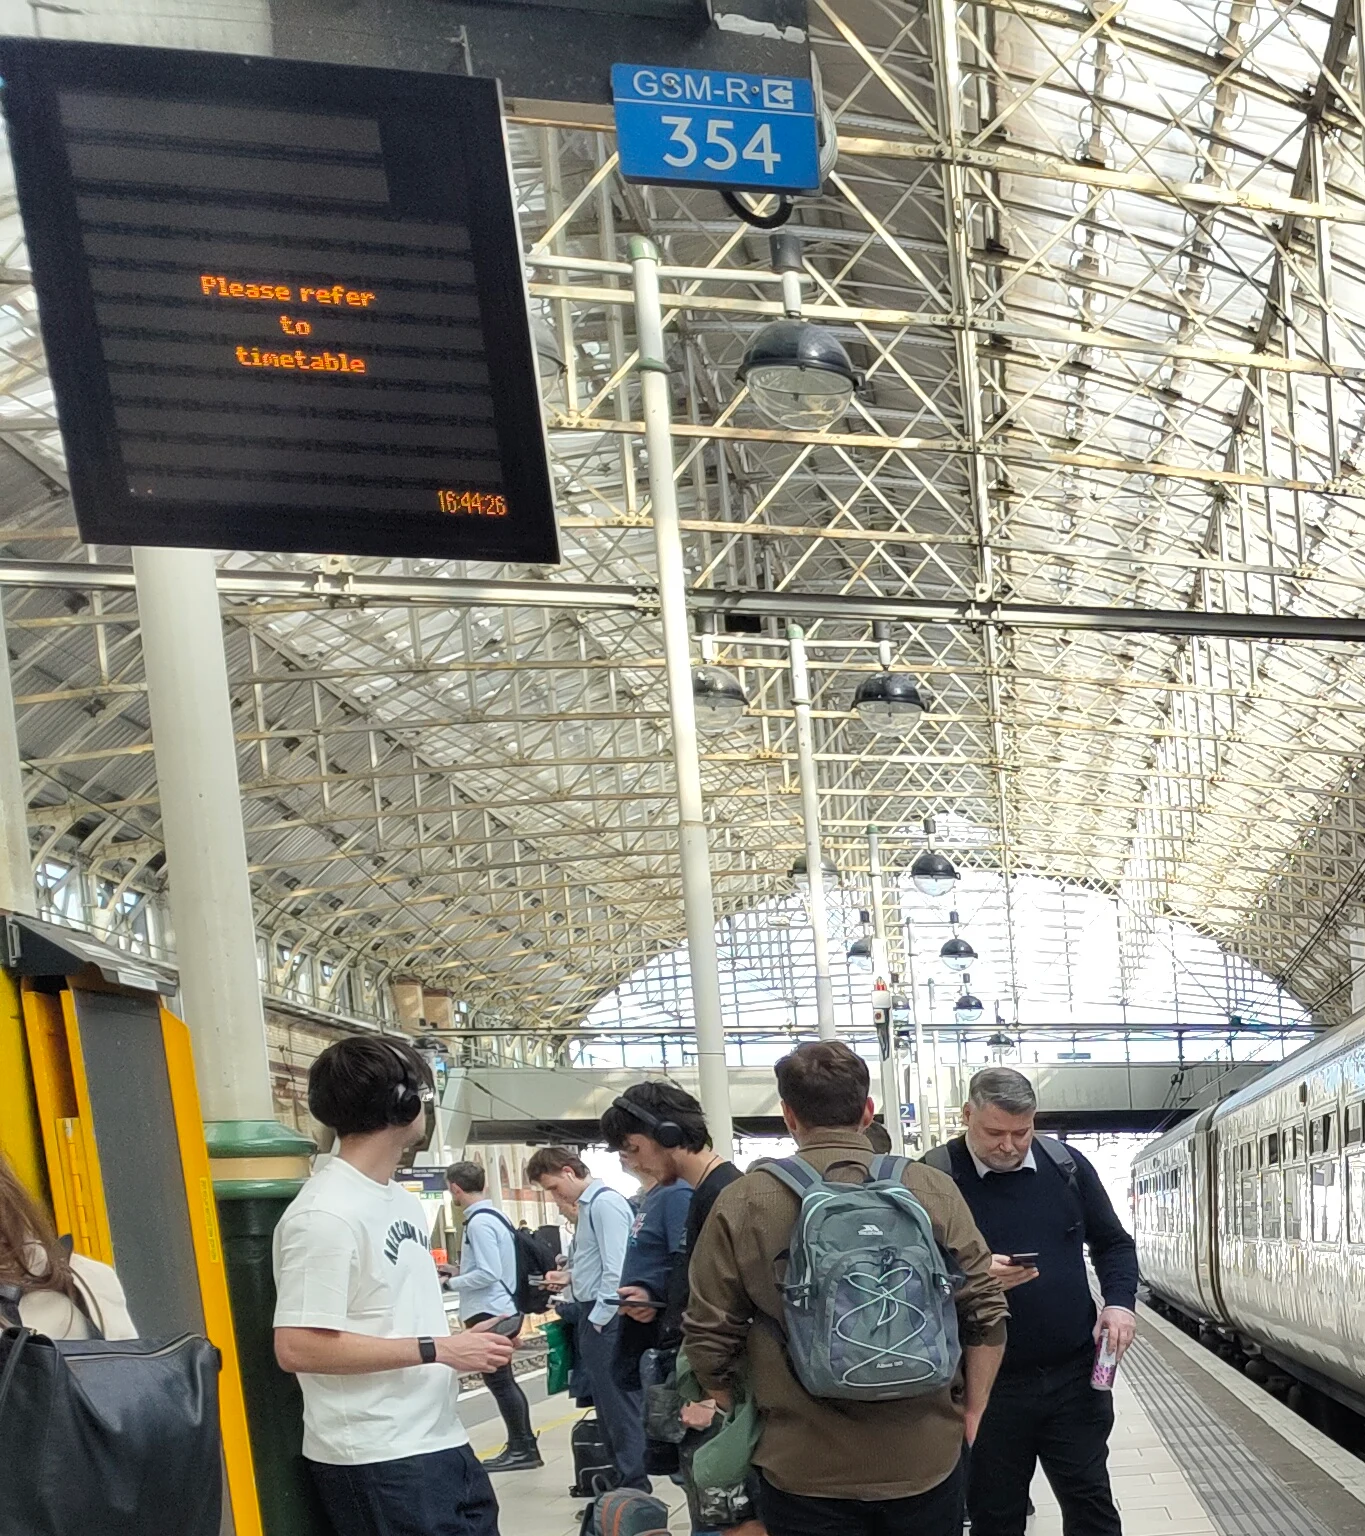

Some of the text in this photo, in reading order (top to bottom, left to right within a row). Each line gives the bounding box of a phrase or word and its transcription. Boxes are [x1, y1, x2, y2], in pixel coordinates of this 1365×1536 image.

[633, 70, 751, 104] GSM-R
[661, 115, 781, 175] 354
[201, 275, 375, 307] Please refer
[279, 315, 311, 336] to
[235, 346, 366, 373] timetable
[437, 490, 507, 515] 16:44:26
